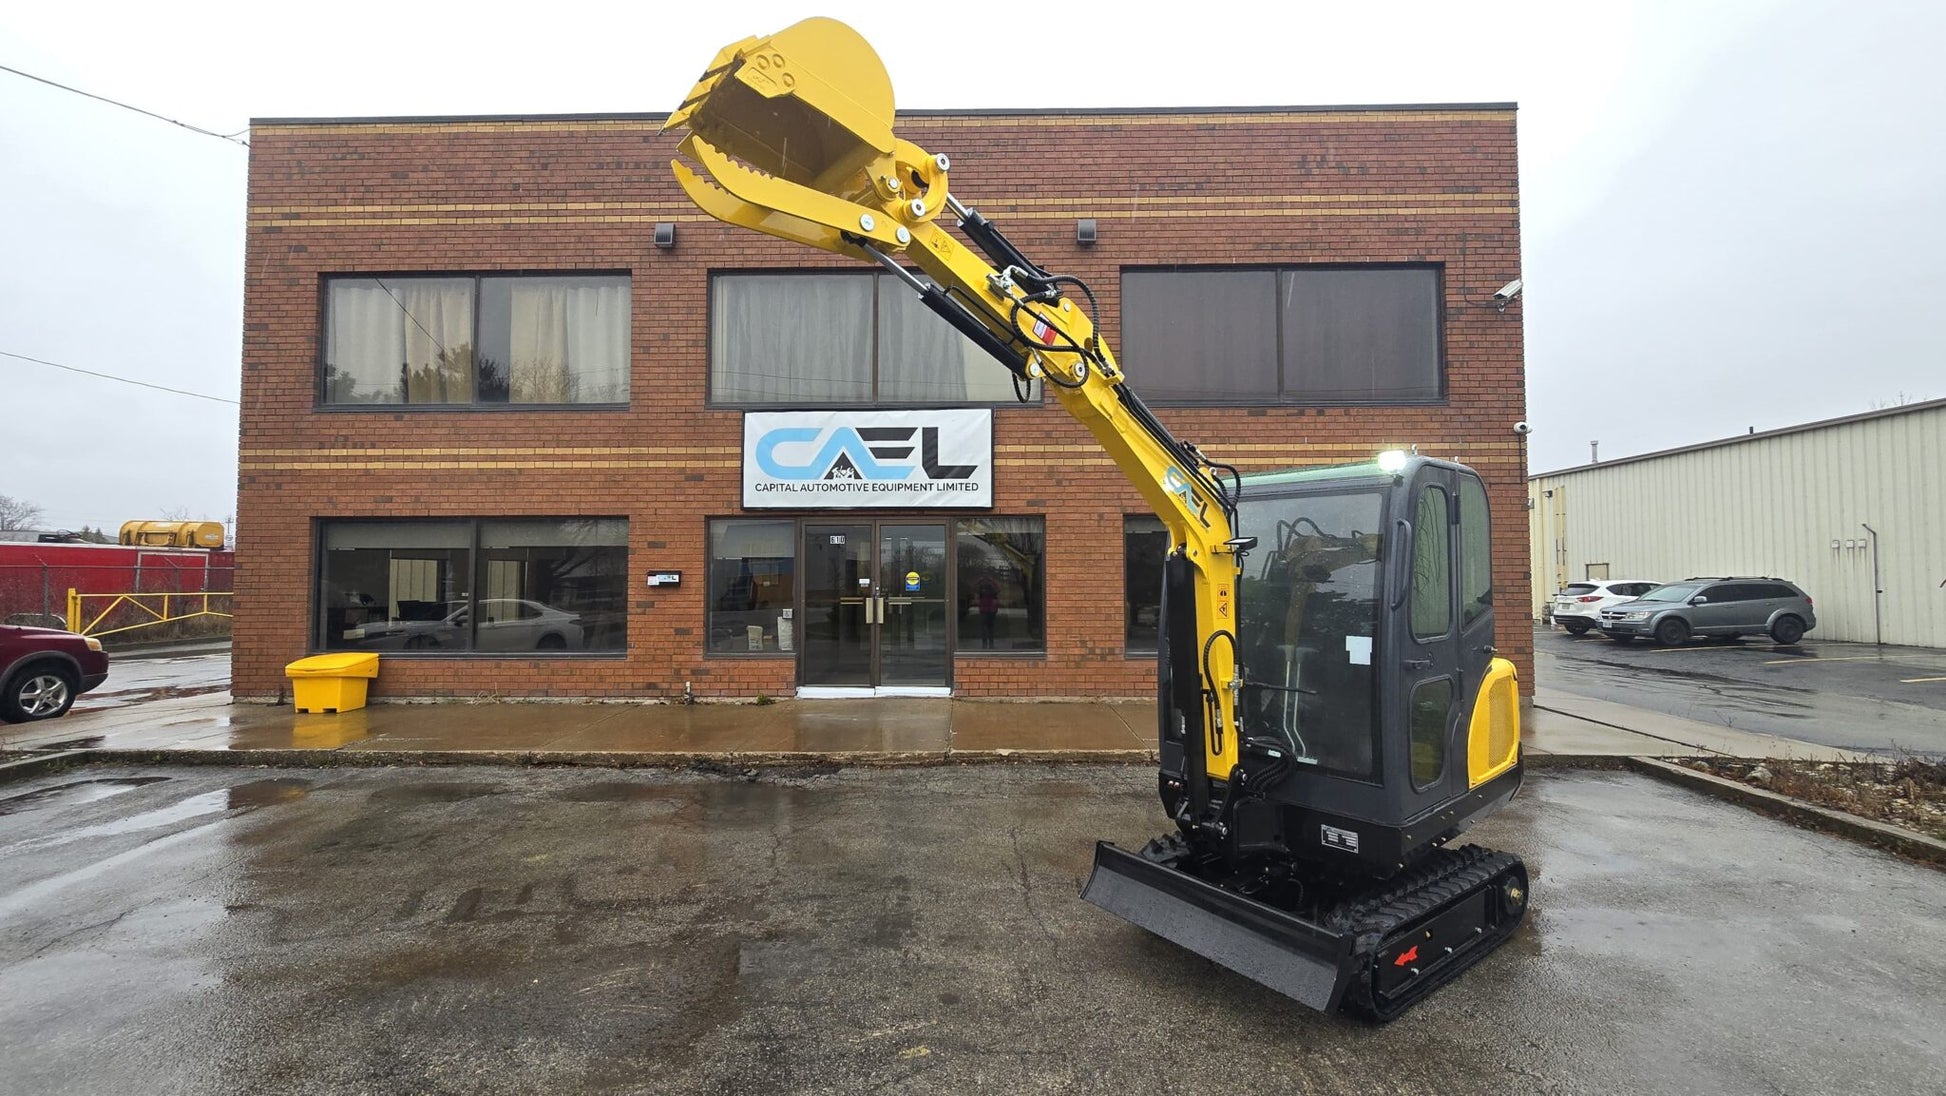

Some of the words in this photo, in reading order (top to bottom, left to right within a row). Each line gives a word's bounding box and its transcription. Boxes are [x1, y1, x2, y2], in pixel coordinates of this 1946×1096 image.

[756, 427, 978, 480] CAEL
[755, 483, 798, 492] CAPITAL
[800, 483, 869, 492] AUTOMOTIVE
[872, 483, 934, 492] EQUIPMENT
[937, 483, 979, 492] LIMITED
[1166, 465, 1211, 528] CAEL
